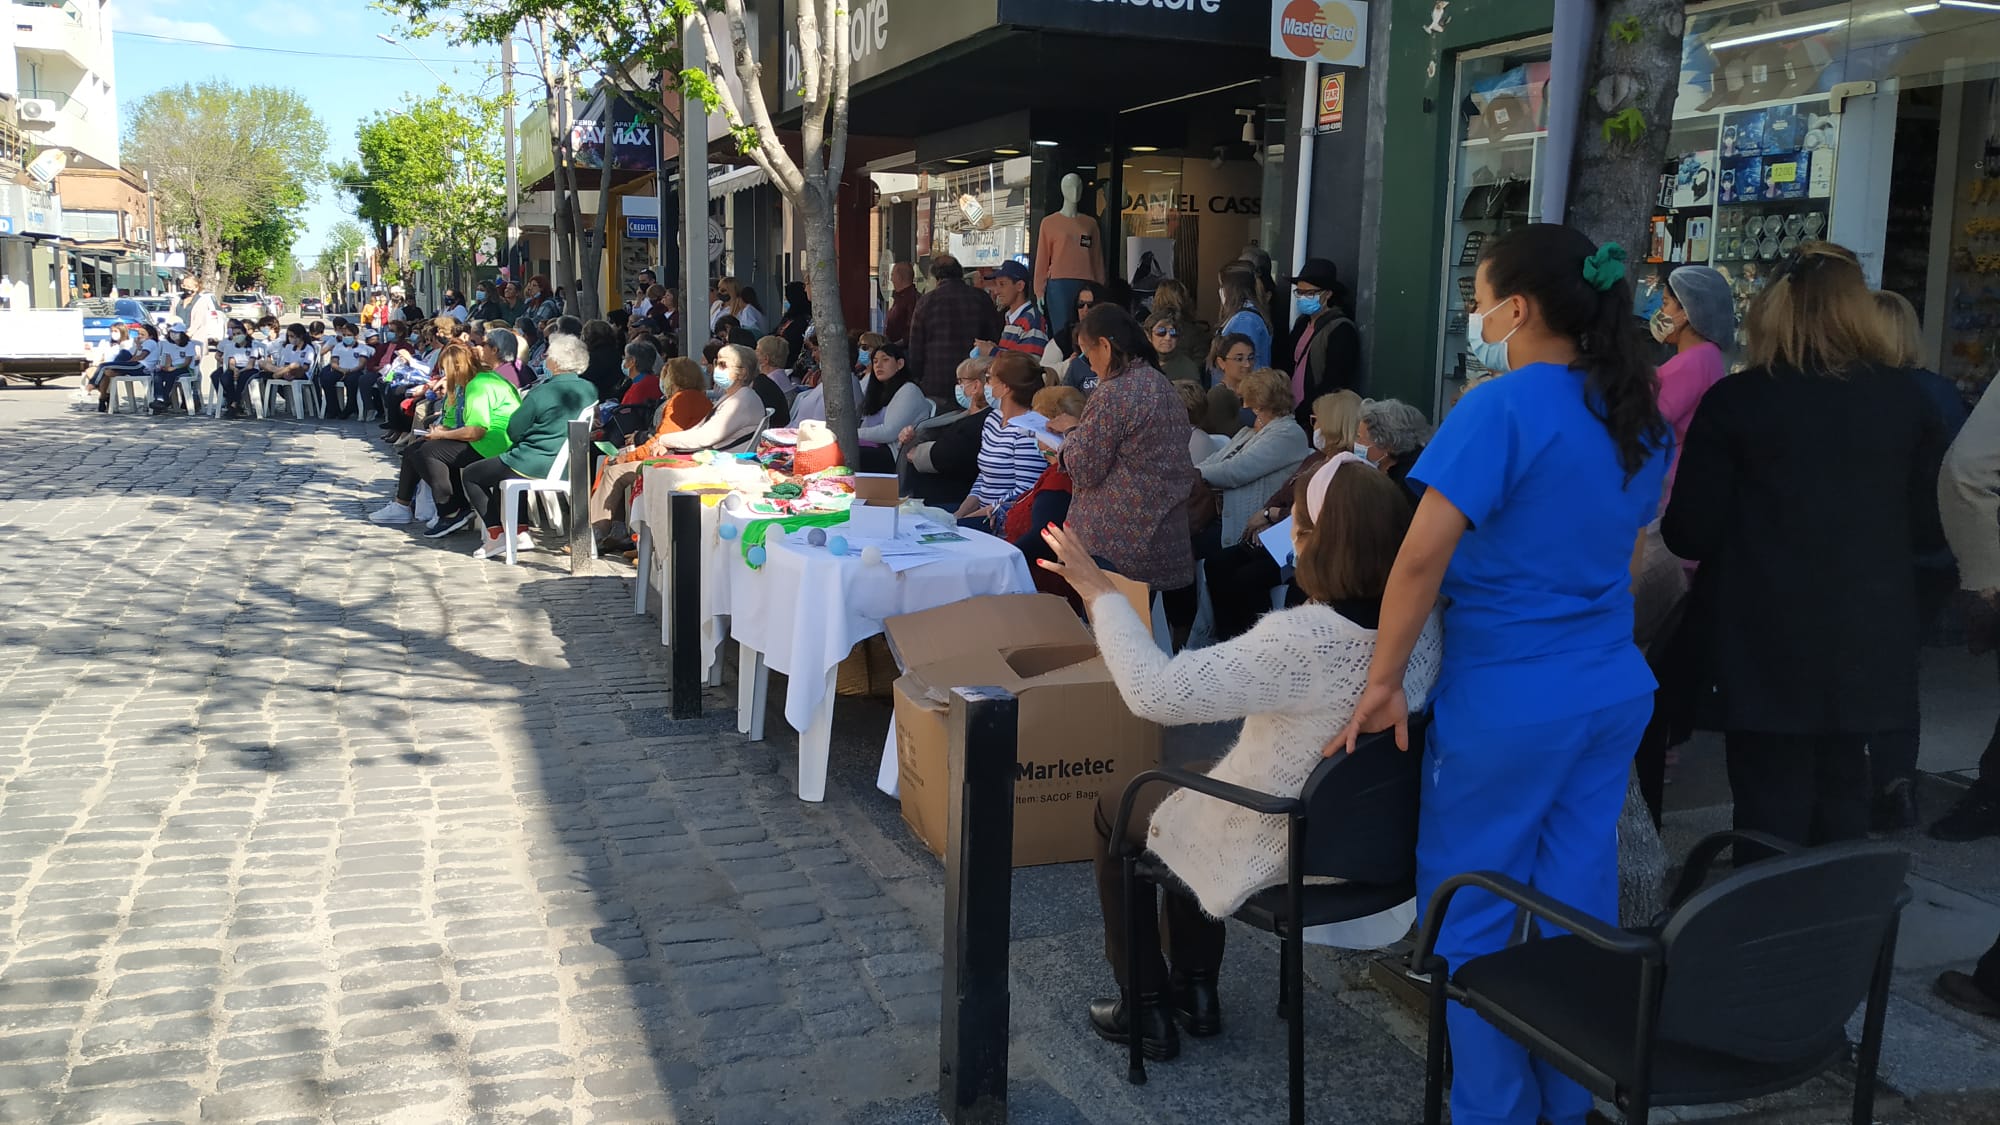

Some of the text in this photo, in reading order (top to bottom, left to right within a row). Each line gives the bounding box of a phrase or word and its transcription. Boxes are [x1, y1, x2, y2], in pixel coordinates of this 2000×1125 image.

[1282, 17, 1354, 41] MasterCard
[629, 221, 657, 232] CREDITEL
[1016, 758, 1114, 781] Marketec
[1040, 792, 1072, 803] SACOF
[1076, 790, 1099, 800] Bags
